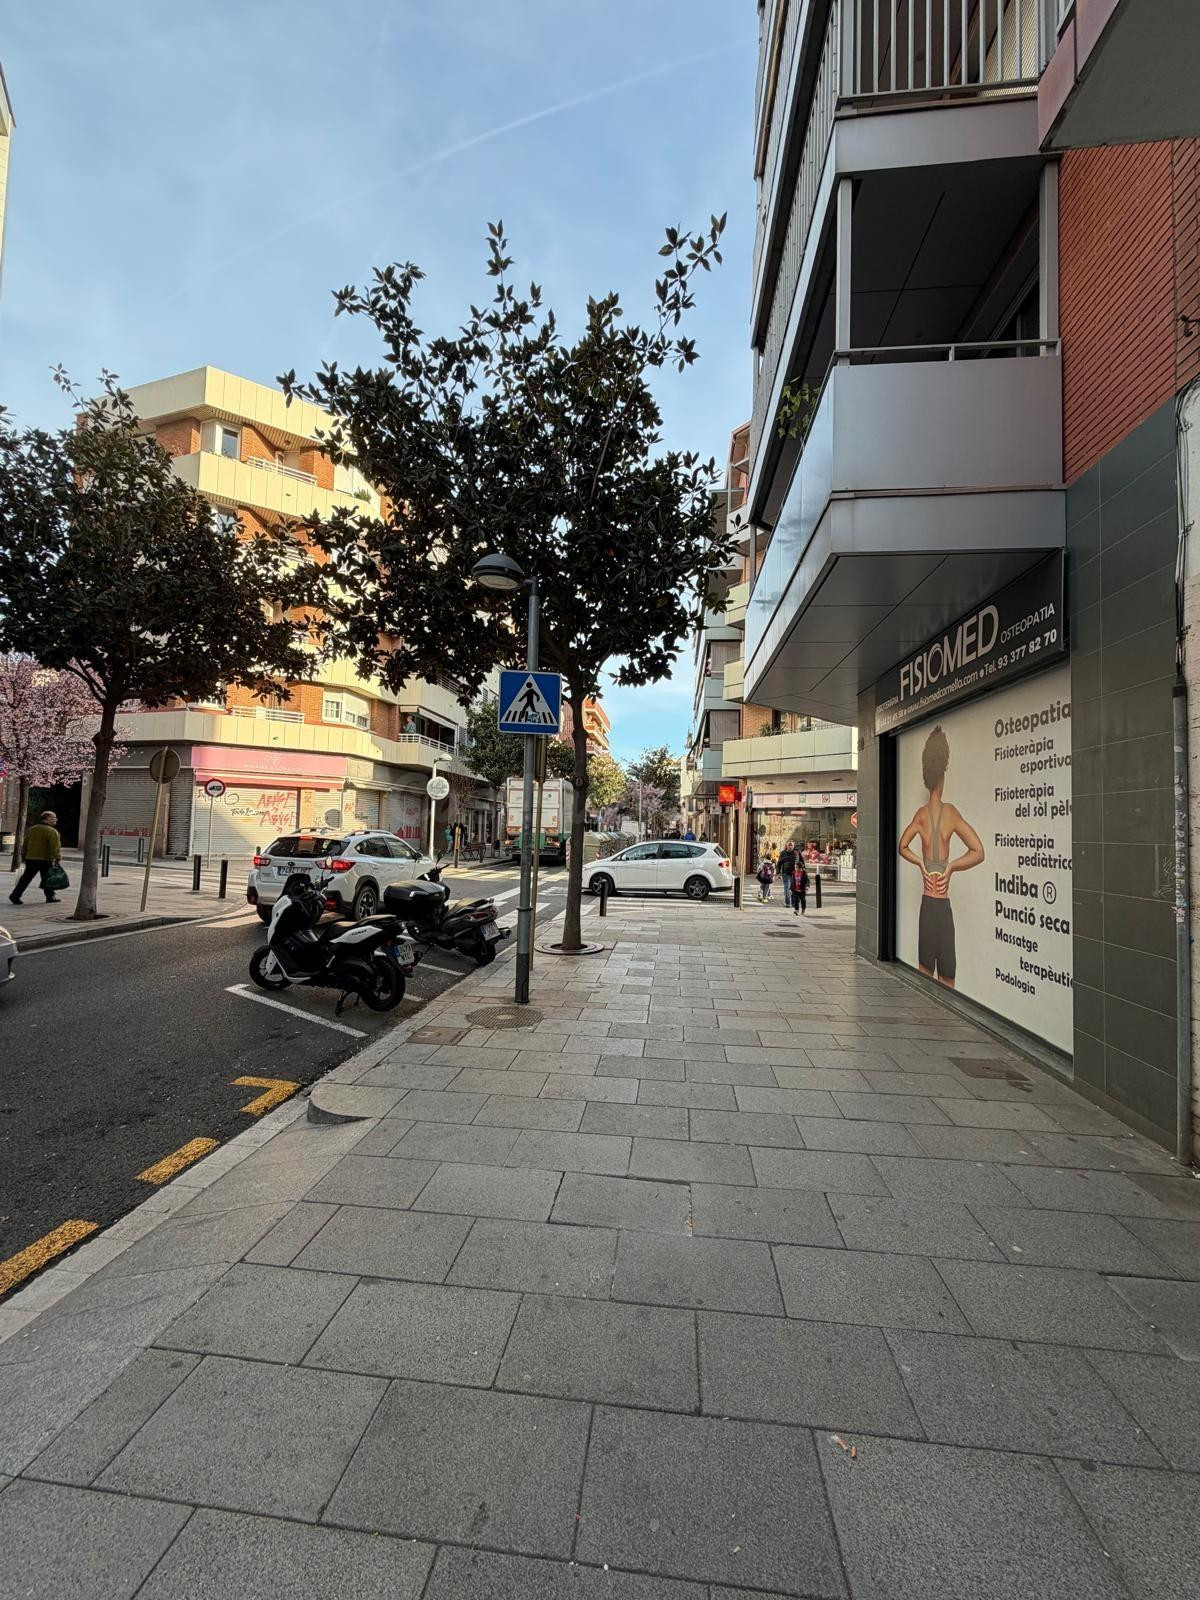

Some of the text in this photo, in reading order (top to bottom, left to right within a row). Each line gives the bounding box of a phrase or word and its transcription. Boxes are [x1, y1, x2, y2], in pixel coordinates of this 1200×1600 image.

[900, 604, 999, 701] FISIOMED
[1000, 602, 1056, 644] OSTEOPATIA
[984, 661, 996, 678] Tel.
[998, 655, 1008, 670] 93
[1010, 645, 1026, 664] 377
[1029, 637, 1041, 653] 82
[1044, 628, 1057, 646] 70
[994, 700, 1072, 738] Osteopatia
[994, 737, 1054, 761] Fisioteràpia
[995, 782, 1054, 802] Fisioteràpia
[1015, 803, 1030, 818] del
[1034, 802, 1047, 817] sòl
[995, 833, 1054, 851] Fisioteràpia
[995, 872, 1038, 898] Indiba
[995, 900, 1070, 935] Punció seca
[995, 927, 1038, 952] Massatge
[995, 968, 1035, 995] Podologia
